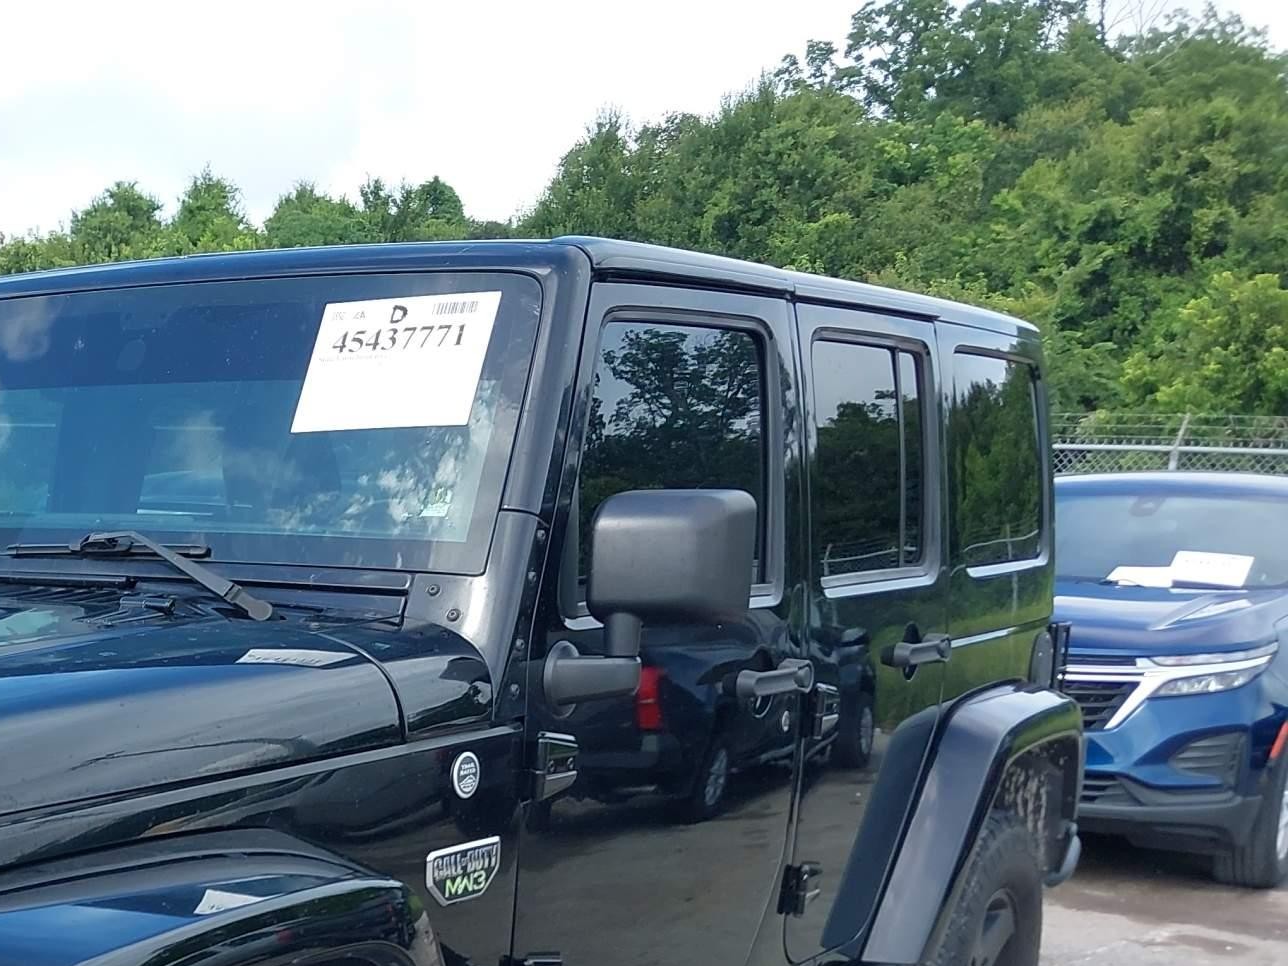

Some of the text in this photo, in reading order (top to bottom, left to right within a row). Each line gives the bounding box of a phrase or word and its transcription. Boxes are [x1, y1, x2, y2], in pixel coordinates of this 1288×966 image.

[390, 305, 408, 324] D
[332, 324, 466, 353] 45437771
[433, 854, 462, 882] CALL
[467, 845, 498, 873] DUTY
[445, 871, 487, 898] MW3
